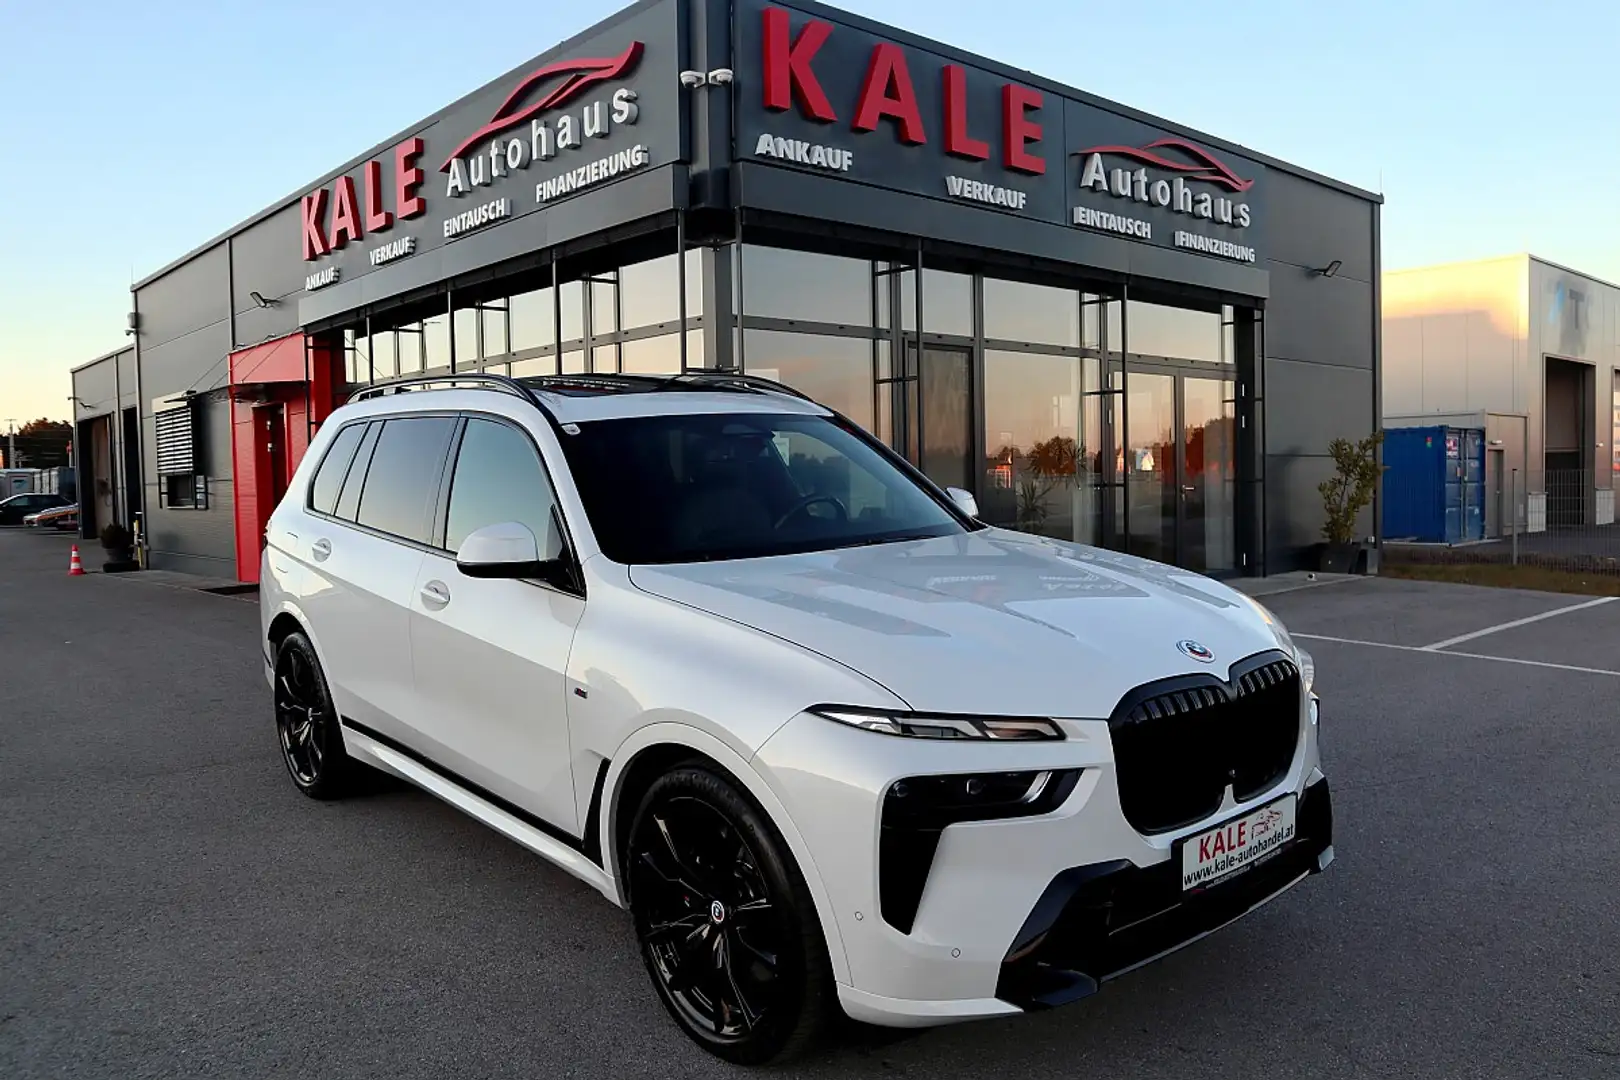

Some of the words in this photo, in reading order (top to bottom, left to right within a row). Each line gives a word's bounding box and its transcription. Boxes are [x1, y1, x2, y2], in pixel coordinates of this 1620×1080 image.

[762, 6, 1046, 175] KALE
[447, 88, 639, 197] Autohaus
[755, 133, 853, 172] ANKAUF
[536, 145, 649, 203] FINANZIERUNG
[944, 175, 1026, 210] VERKAUF
[1081, 152, 1250, 228] Autohaus
[301, 137, 426, 261] KALE
[443, 198, 512, 238] EINTAUSCH
[1073, 206, 1151, 239] EINTAUSCH
[369, 236, 417, 266] VERKAUF
[1174, 230, 1255, 263] FINANZIERUNG
[305, 266, 341, 291] ANKAUF
[1184, 824, 1294, 886] www.kale-autohandel.at
[1199, 821, 1247, 864] KALE
